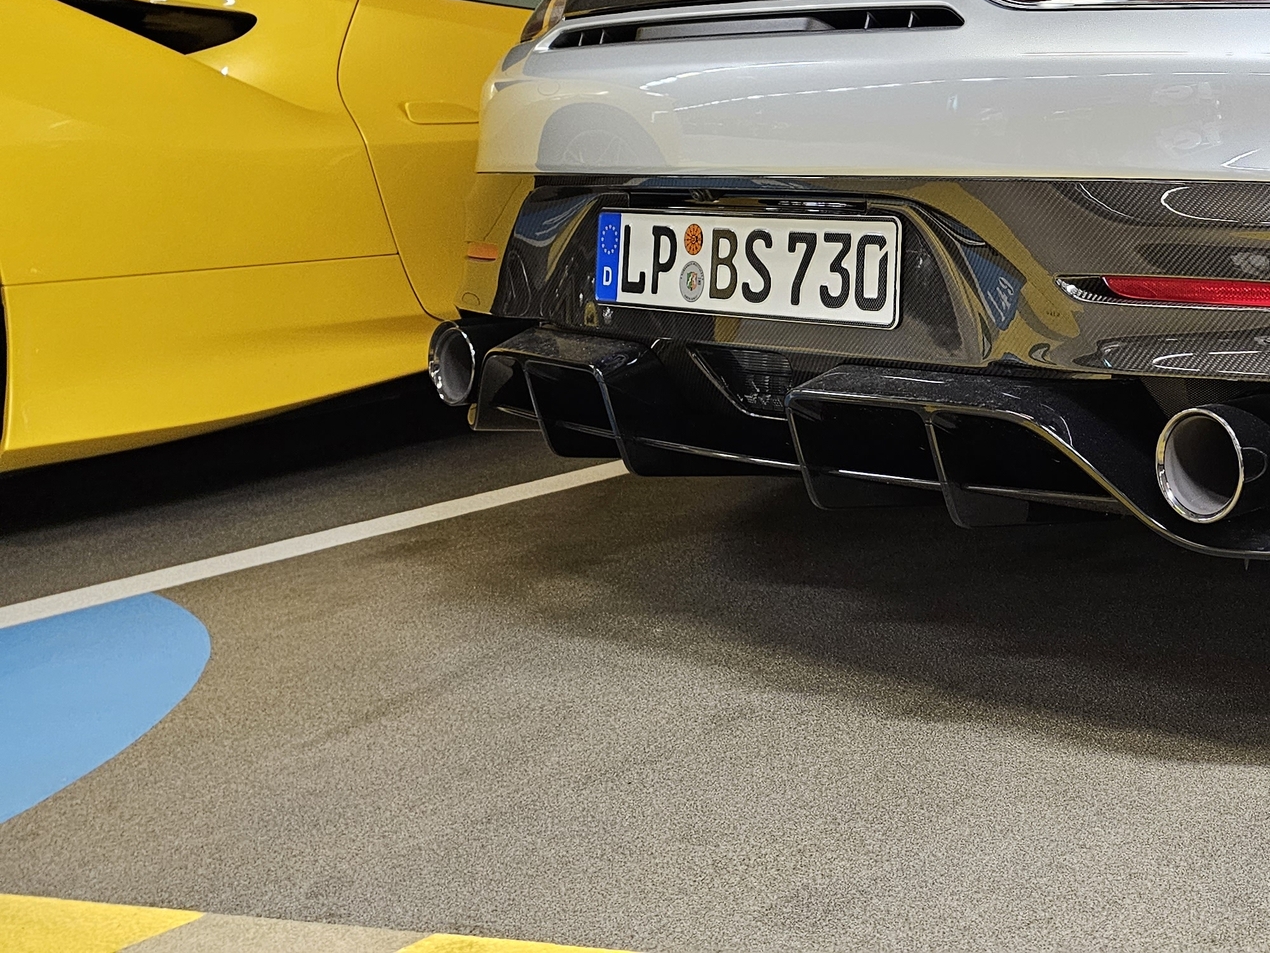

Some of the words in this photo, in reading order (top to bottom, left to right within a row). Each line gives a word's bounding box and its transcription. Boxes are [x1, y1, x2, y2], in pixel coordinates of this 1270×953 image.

[603, 266, 612, 286] D
[621, 224, 678, 295] LP
[709, 228, 773, 303] BS
[788, 231, 888, 311] 730
